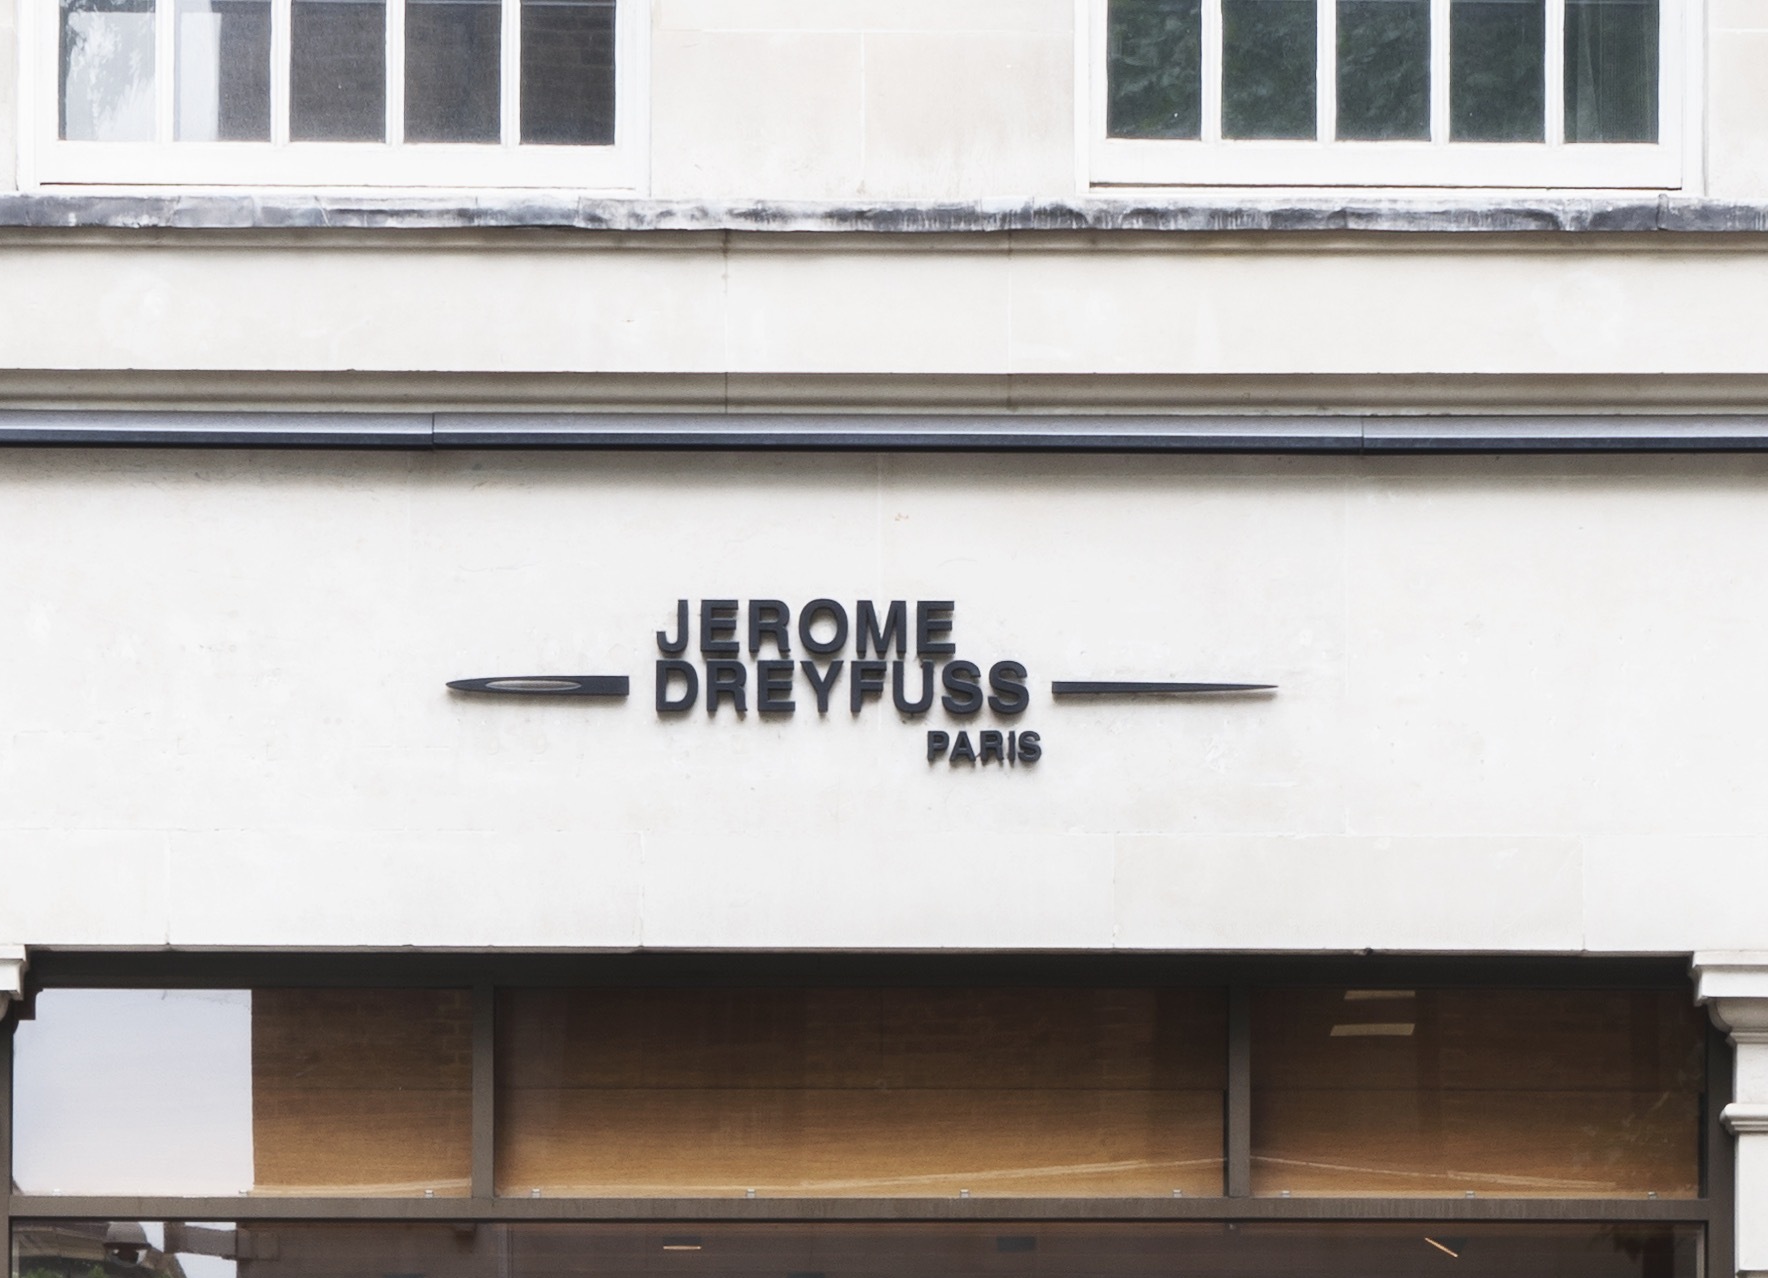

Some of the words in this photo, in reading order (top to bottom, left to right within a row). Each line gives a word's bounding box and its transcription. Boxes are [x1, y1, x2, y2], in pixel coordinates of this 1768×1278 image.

[656, 598, 957, 656] JEROME
[655, 659, 1030, 715] DREYFUSS
[926, 730, 1043, 763] PARIS
